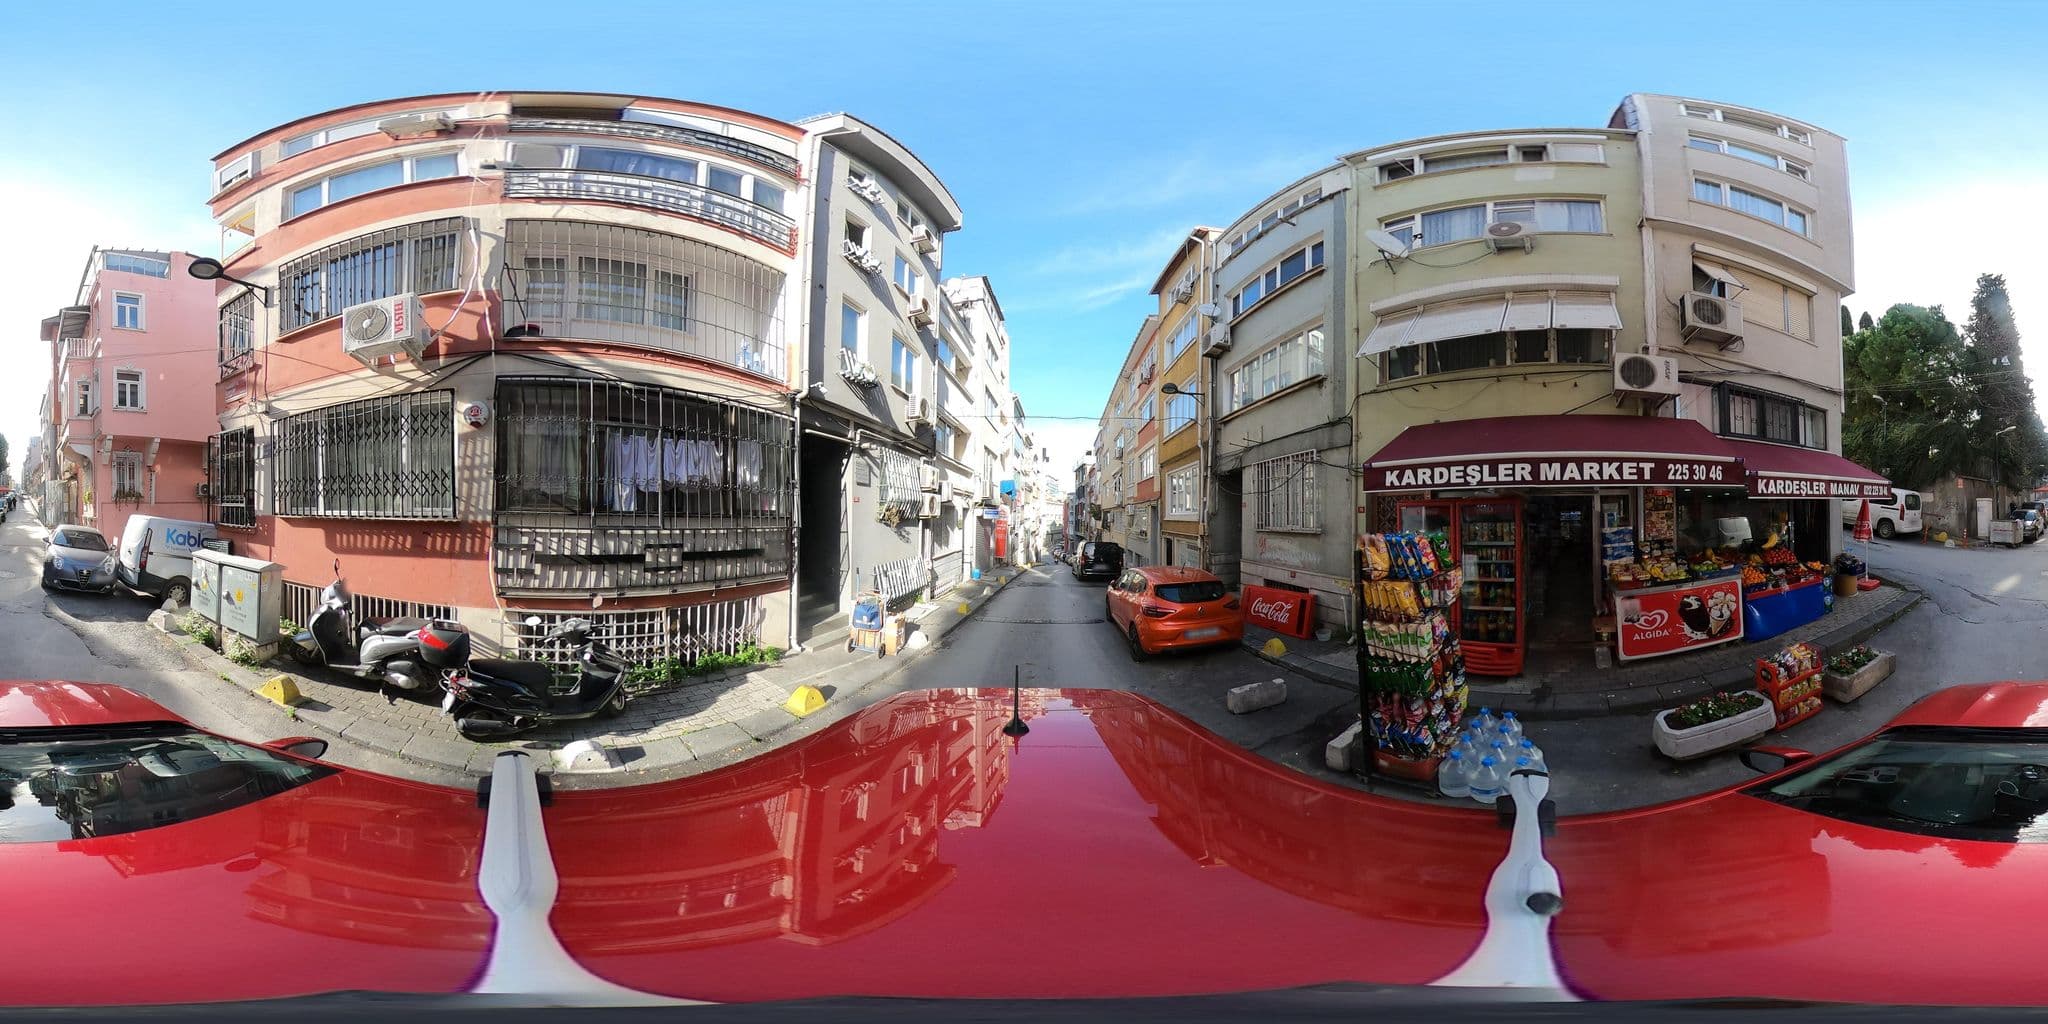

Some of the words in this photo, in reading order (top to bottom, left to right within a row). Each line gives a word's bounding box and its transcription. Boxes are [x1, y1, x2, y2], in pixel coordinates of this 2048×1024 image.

[394, 300, 404, 334] VESTEL
[1385, 463, 1532, 486] KARDEŞLER
[1540, 462, 1655, 481] MARKET
[1667, 463, 1690, 481] 225
[1692, 464, 1706, 481] 30
[1709, 465, 1723, 481] 46
[1757, 478, 1827, 496] KARDEŞLER
[1830, 483, 1860, 496] MANAV
[1633, 629, 1669, 641] ALGIDA
